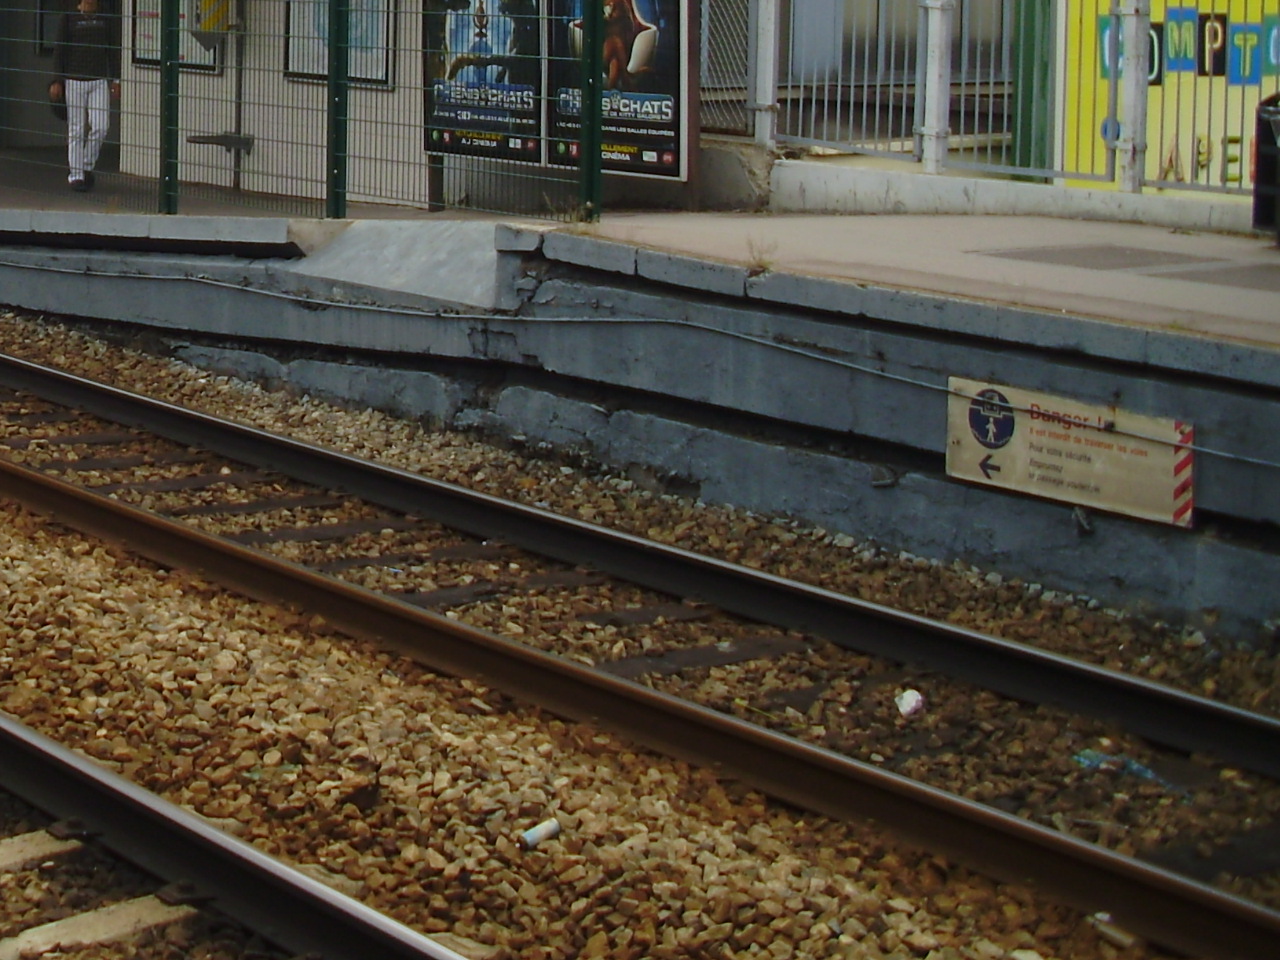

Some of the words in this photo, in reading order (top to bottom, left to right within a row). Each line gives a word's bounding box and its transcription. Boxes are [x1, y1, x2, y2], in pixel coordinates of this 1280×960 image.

[619, 99, 673, 120] CHATS
[601, 143, 639, 153] ELLEMENT
[601, 151, 631, 161] CINÉMA
[1030, 403, 1090, 431] Danger
